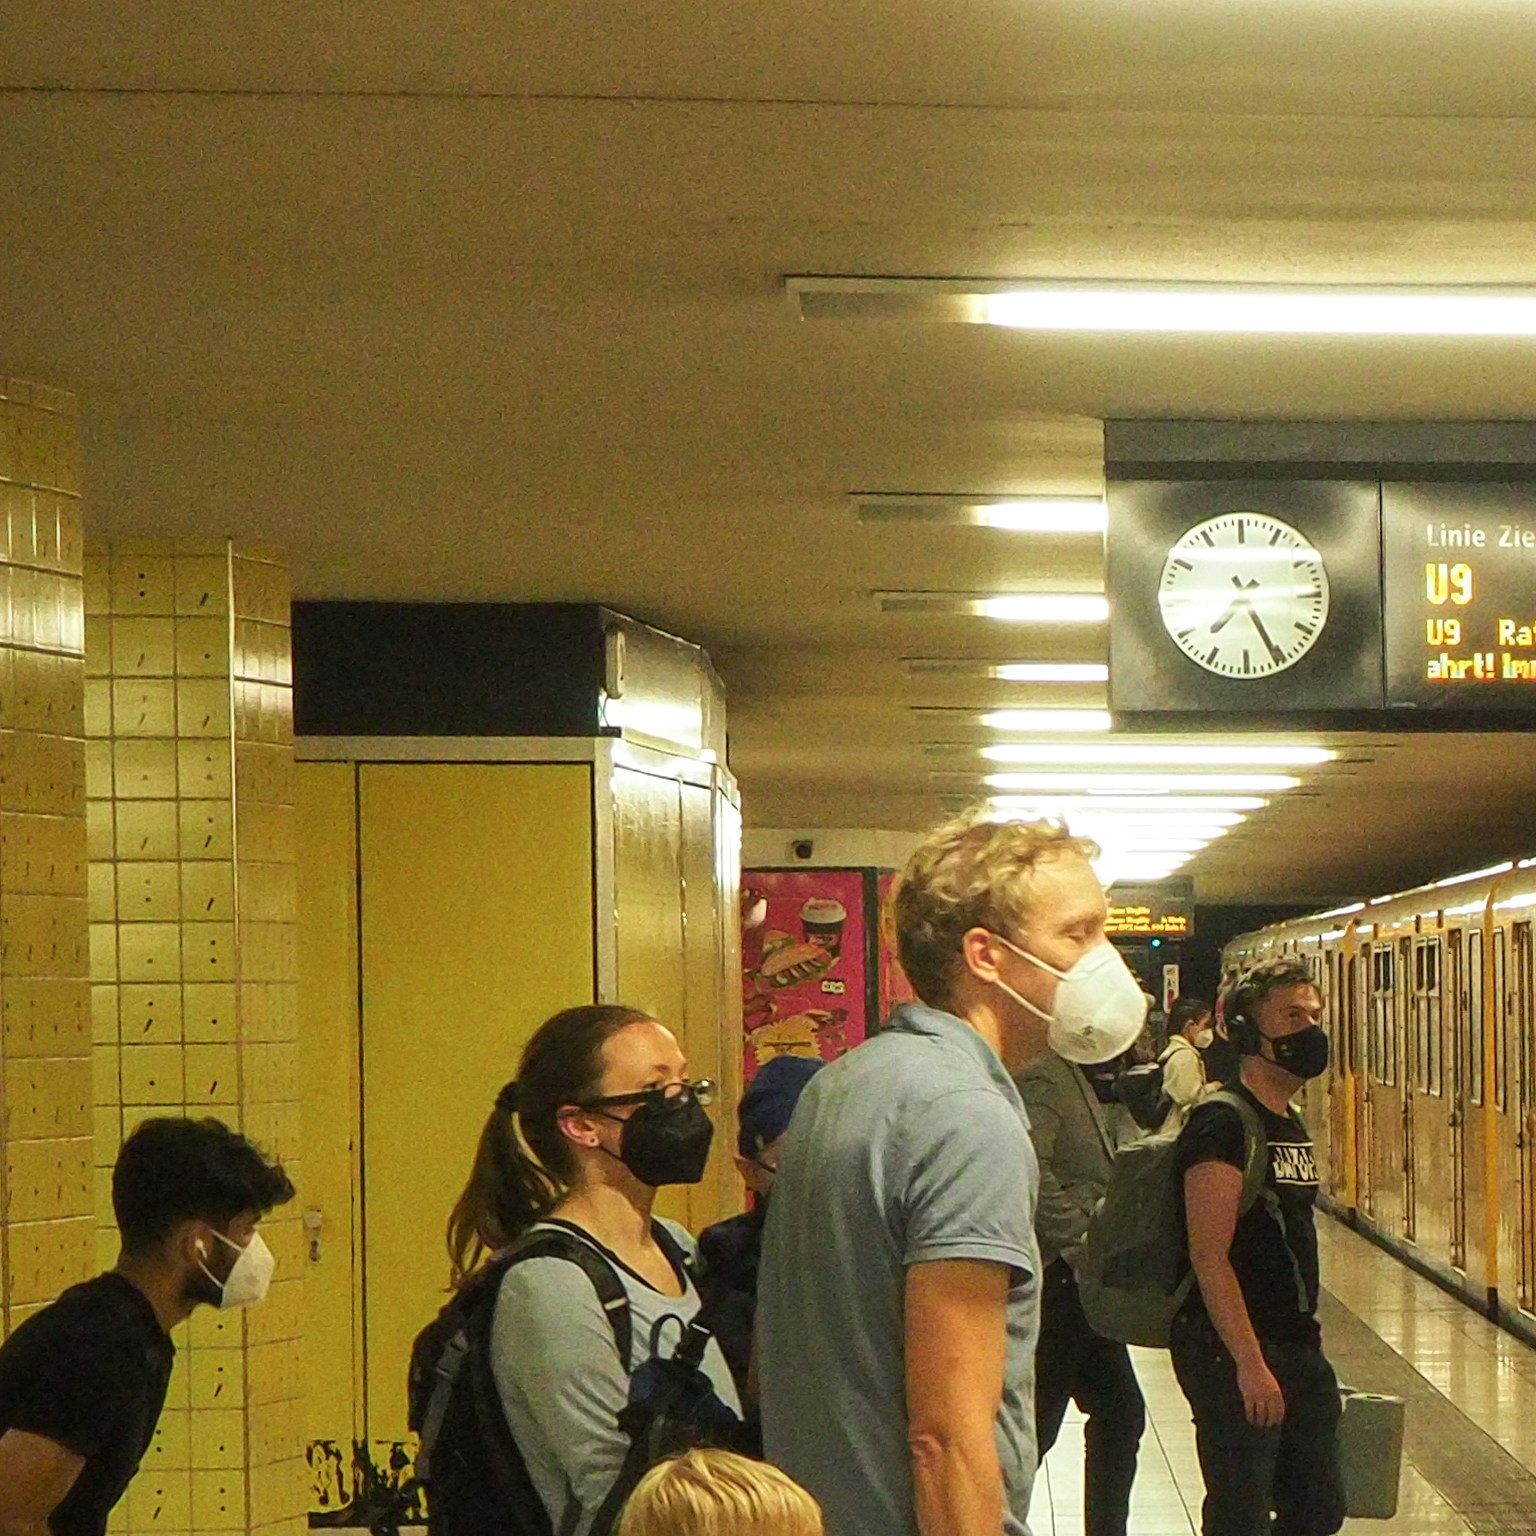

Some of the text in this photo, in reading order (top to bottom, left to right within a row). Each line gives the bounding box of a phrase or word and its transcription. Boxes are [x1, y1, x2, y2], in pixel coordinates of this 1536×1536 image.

[1426, 522, 1487, 548] Linie
[1425, 562, 1474, 606] U9
[1426, 618, 1462, 646] U9
[1427, 652, 1496, 680] ahrt!
